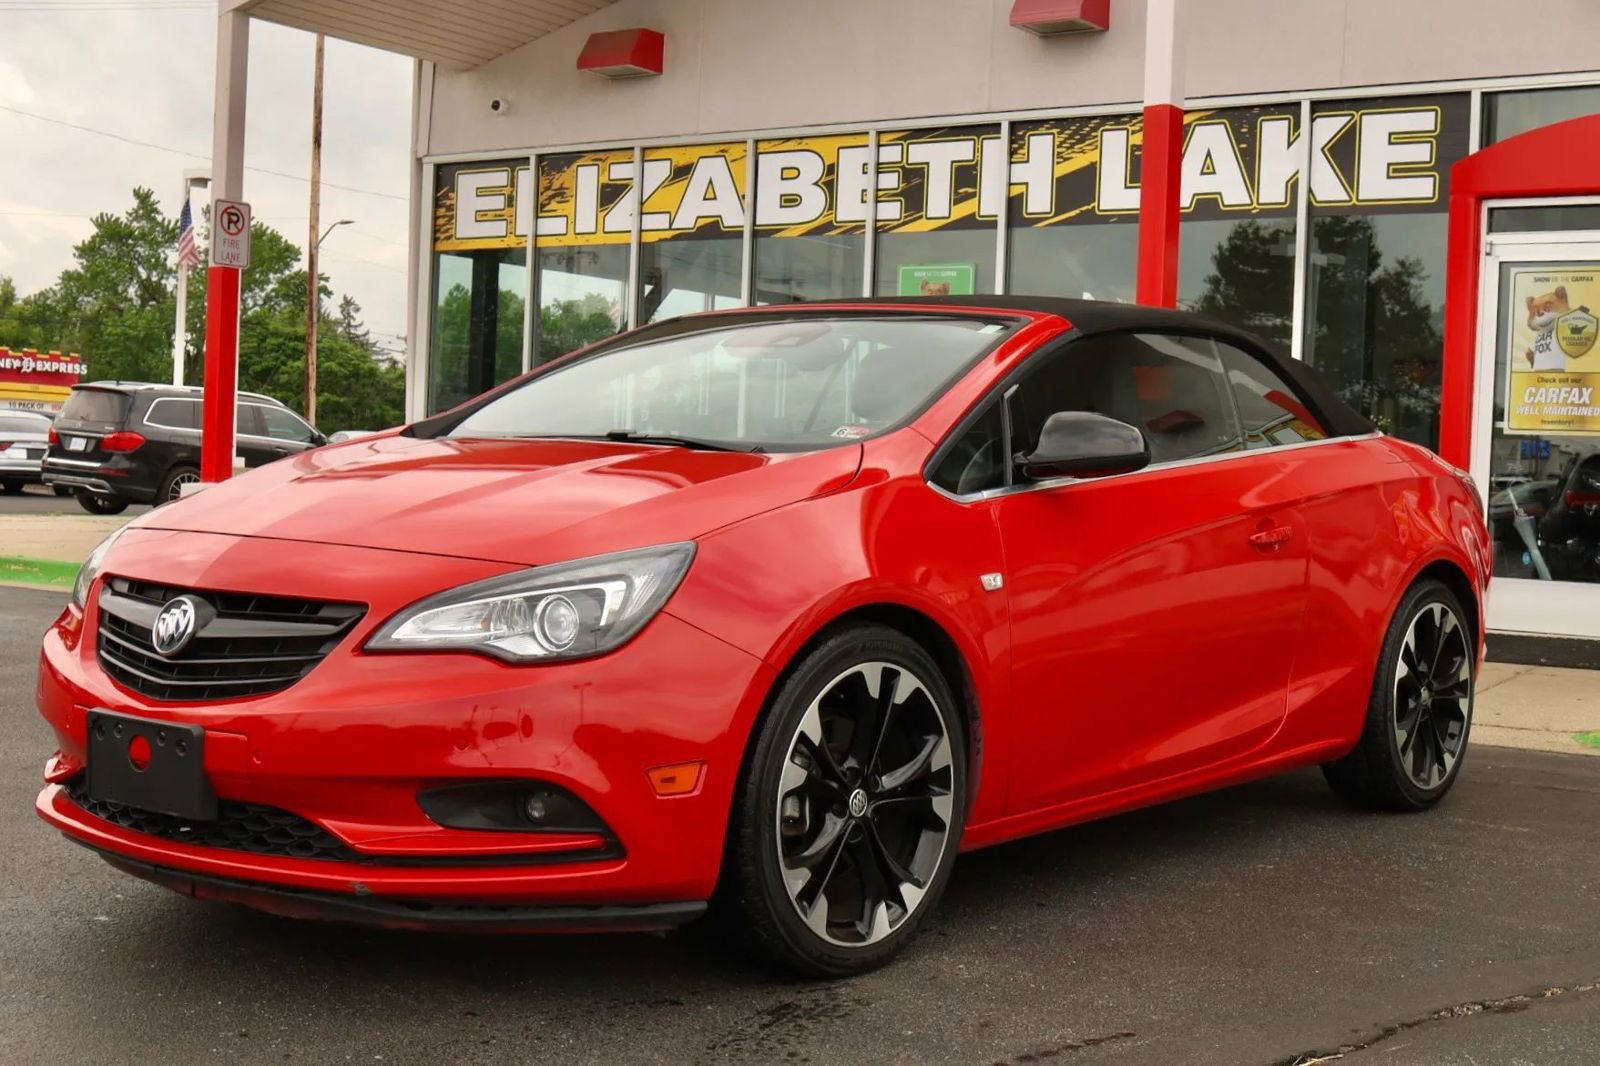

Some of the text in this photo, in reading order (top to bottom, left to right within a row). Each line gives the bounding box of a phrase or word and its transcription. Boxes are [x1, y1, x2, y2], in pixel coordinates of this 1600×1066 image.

[454, 107, 1440, 240] ELIZABETH LAKE
[223, 238, 241, 250] FIRE
[220, 251, 241, 262] LANE
[36, 360, 88, 375] EXPRESS
[1536, 376, 1556, 384] Check
[1523, 386, 1593, 404] CARFAX
[18, 401, 35, 409] PACK
[1516, 405, 1539, 416] WELL
